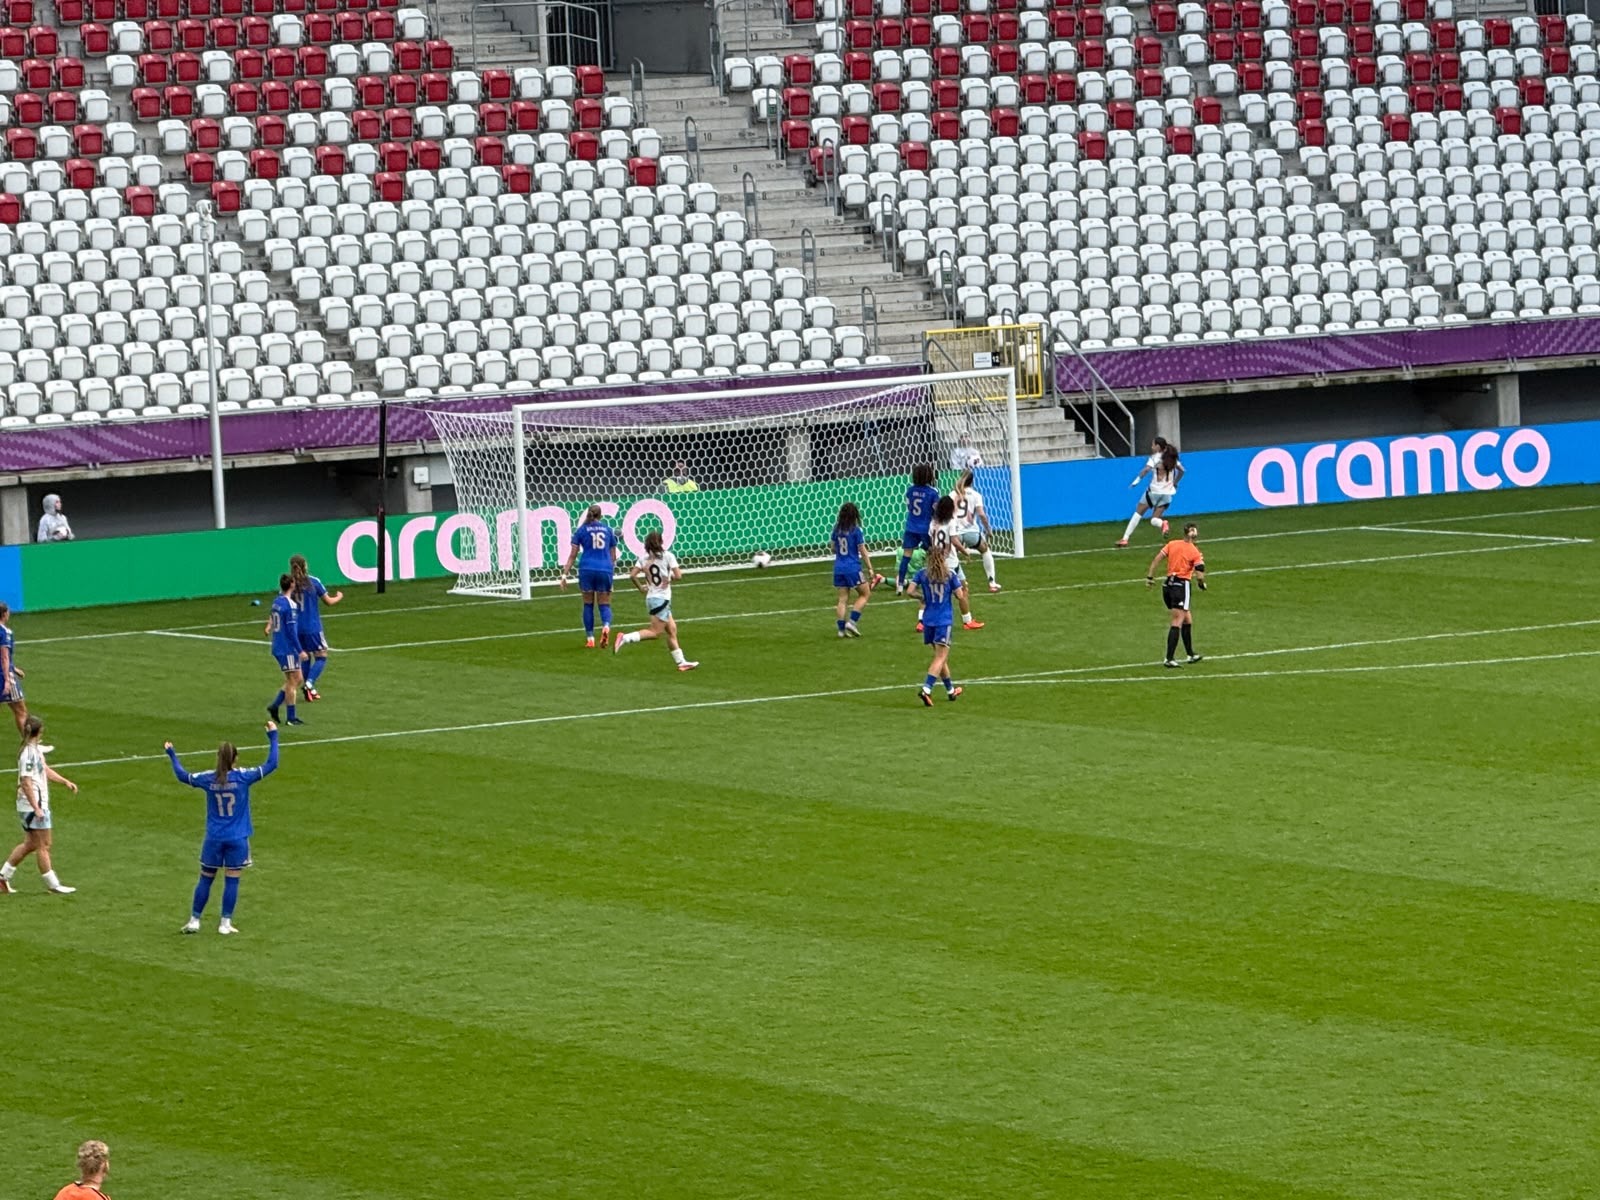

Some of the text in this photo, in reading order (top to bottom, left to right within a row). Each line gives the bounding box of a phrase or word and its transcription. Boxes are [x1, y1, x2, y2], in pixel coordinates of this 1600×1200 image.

[675, 100, 684, 110] 11
[703, 132, 712, 142] 10
[732, 164, 738, 173] 9
[1248, 429, 1550, 507] aramco
[912, 498, 923, 516] 5
[956, 499, 969, 518] 9
[590, 532, 606, 550] 16
[932, 529, 946, 549] 18
[648, 563, 662, 587] 8
[929, 582, 945, 604] 14
[214, 792, 236, 817] 17
